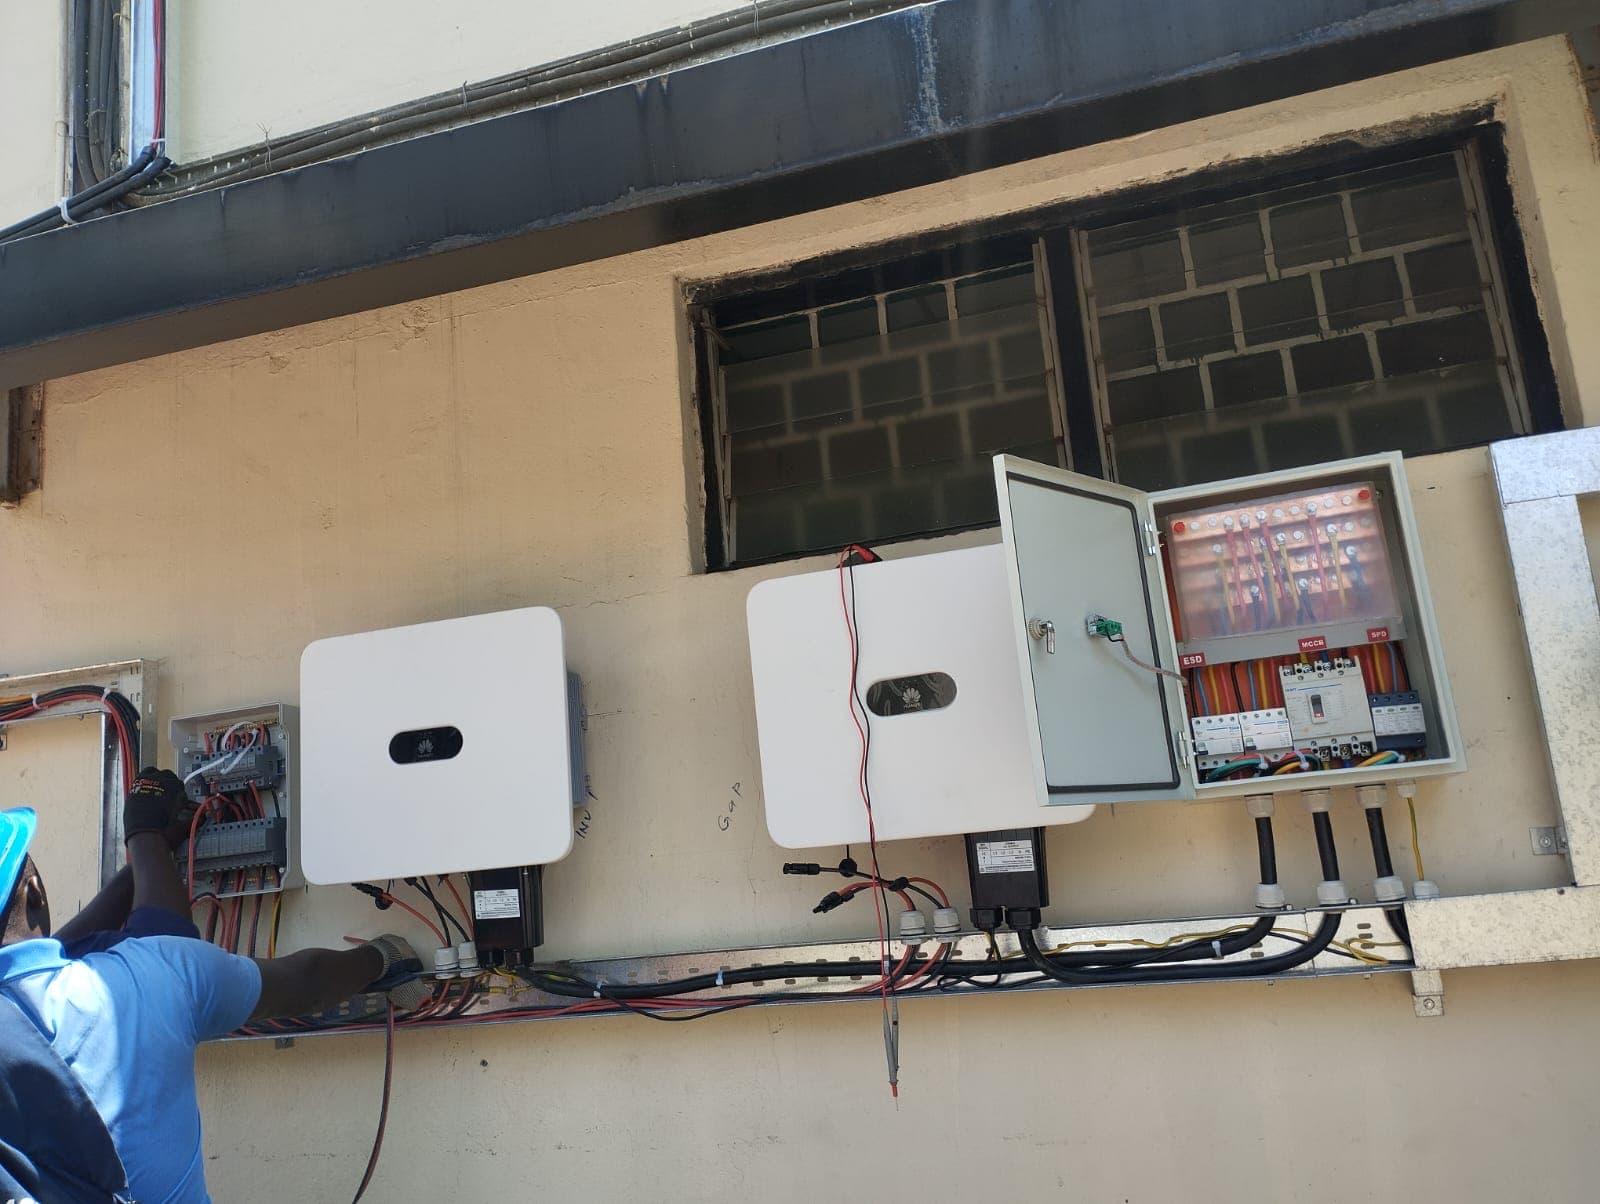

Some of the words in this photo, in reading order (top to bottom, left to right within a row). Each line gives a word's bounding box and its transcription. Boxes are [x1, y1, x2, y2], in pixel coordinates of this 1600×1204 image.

[1371, 631, 1387, 639] SPD
[1301, 639, 1325, 648] MCCB
[1183, 655, 1202, 665] ESD
